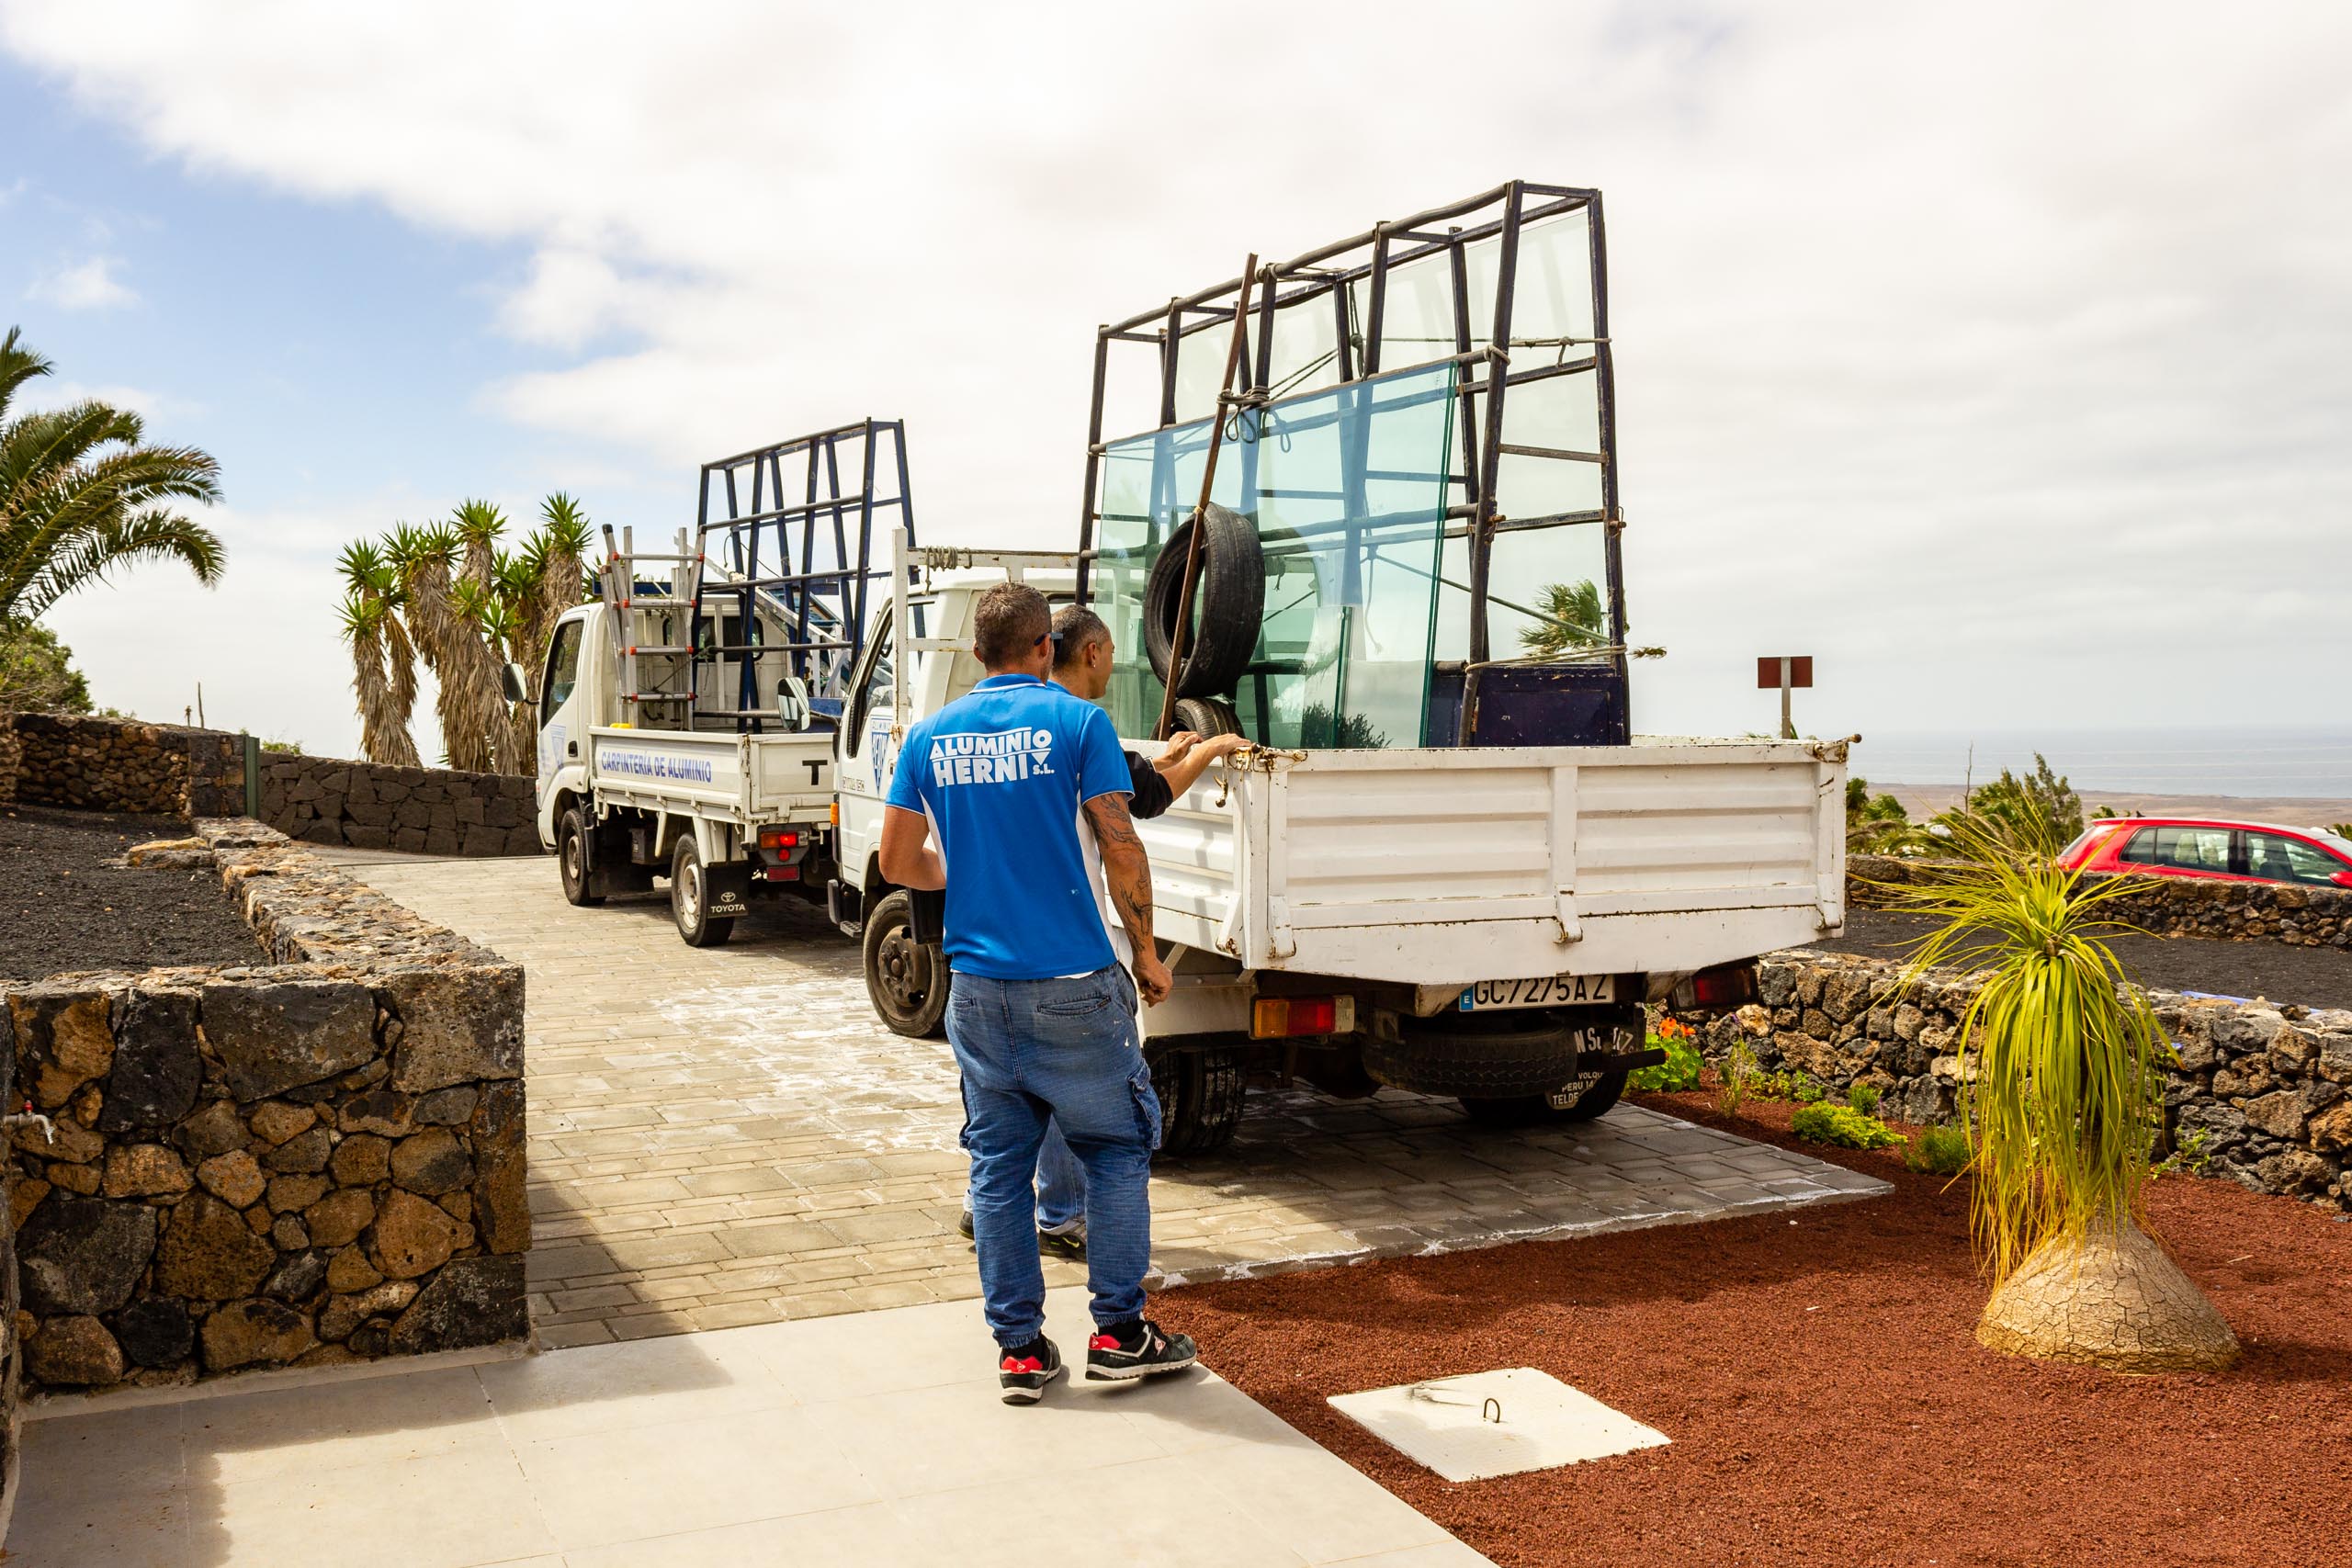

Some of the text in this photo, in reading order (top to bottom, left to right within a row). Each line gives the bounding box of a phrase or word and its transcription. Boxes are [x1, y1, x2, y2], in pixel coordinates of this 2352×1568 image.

[930, 729, 1053, 760] ALUMINIO
[601, 750, 712, 783] CARPINTERÍA DE ALUMINIO
[802, 760, 828, 785] T
[933, 753, 1055, 787] HERNI S.L.
[710, 904, 746, 913] TOYOTA
